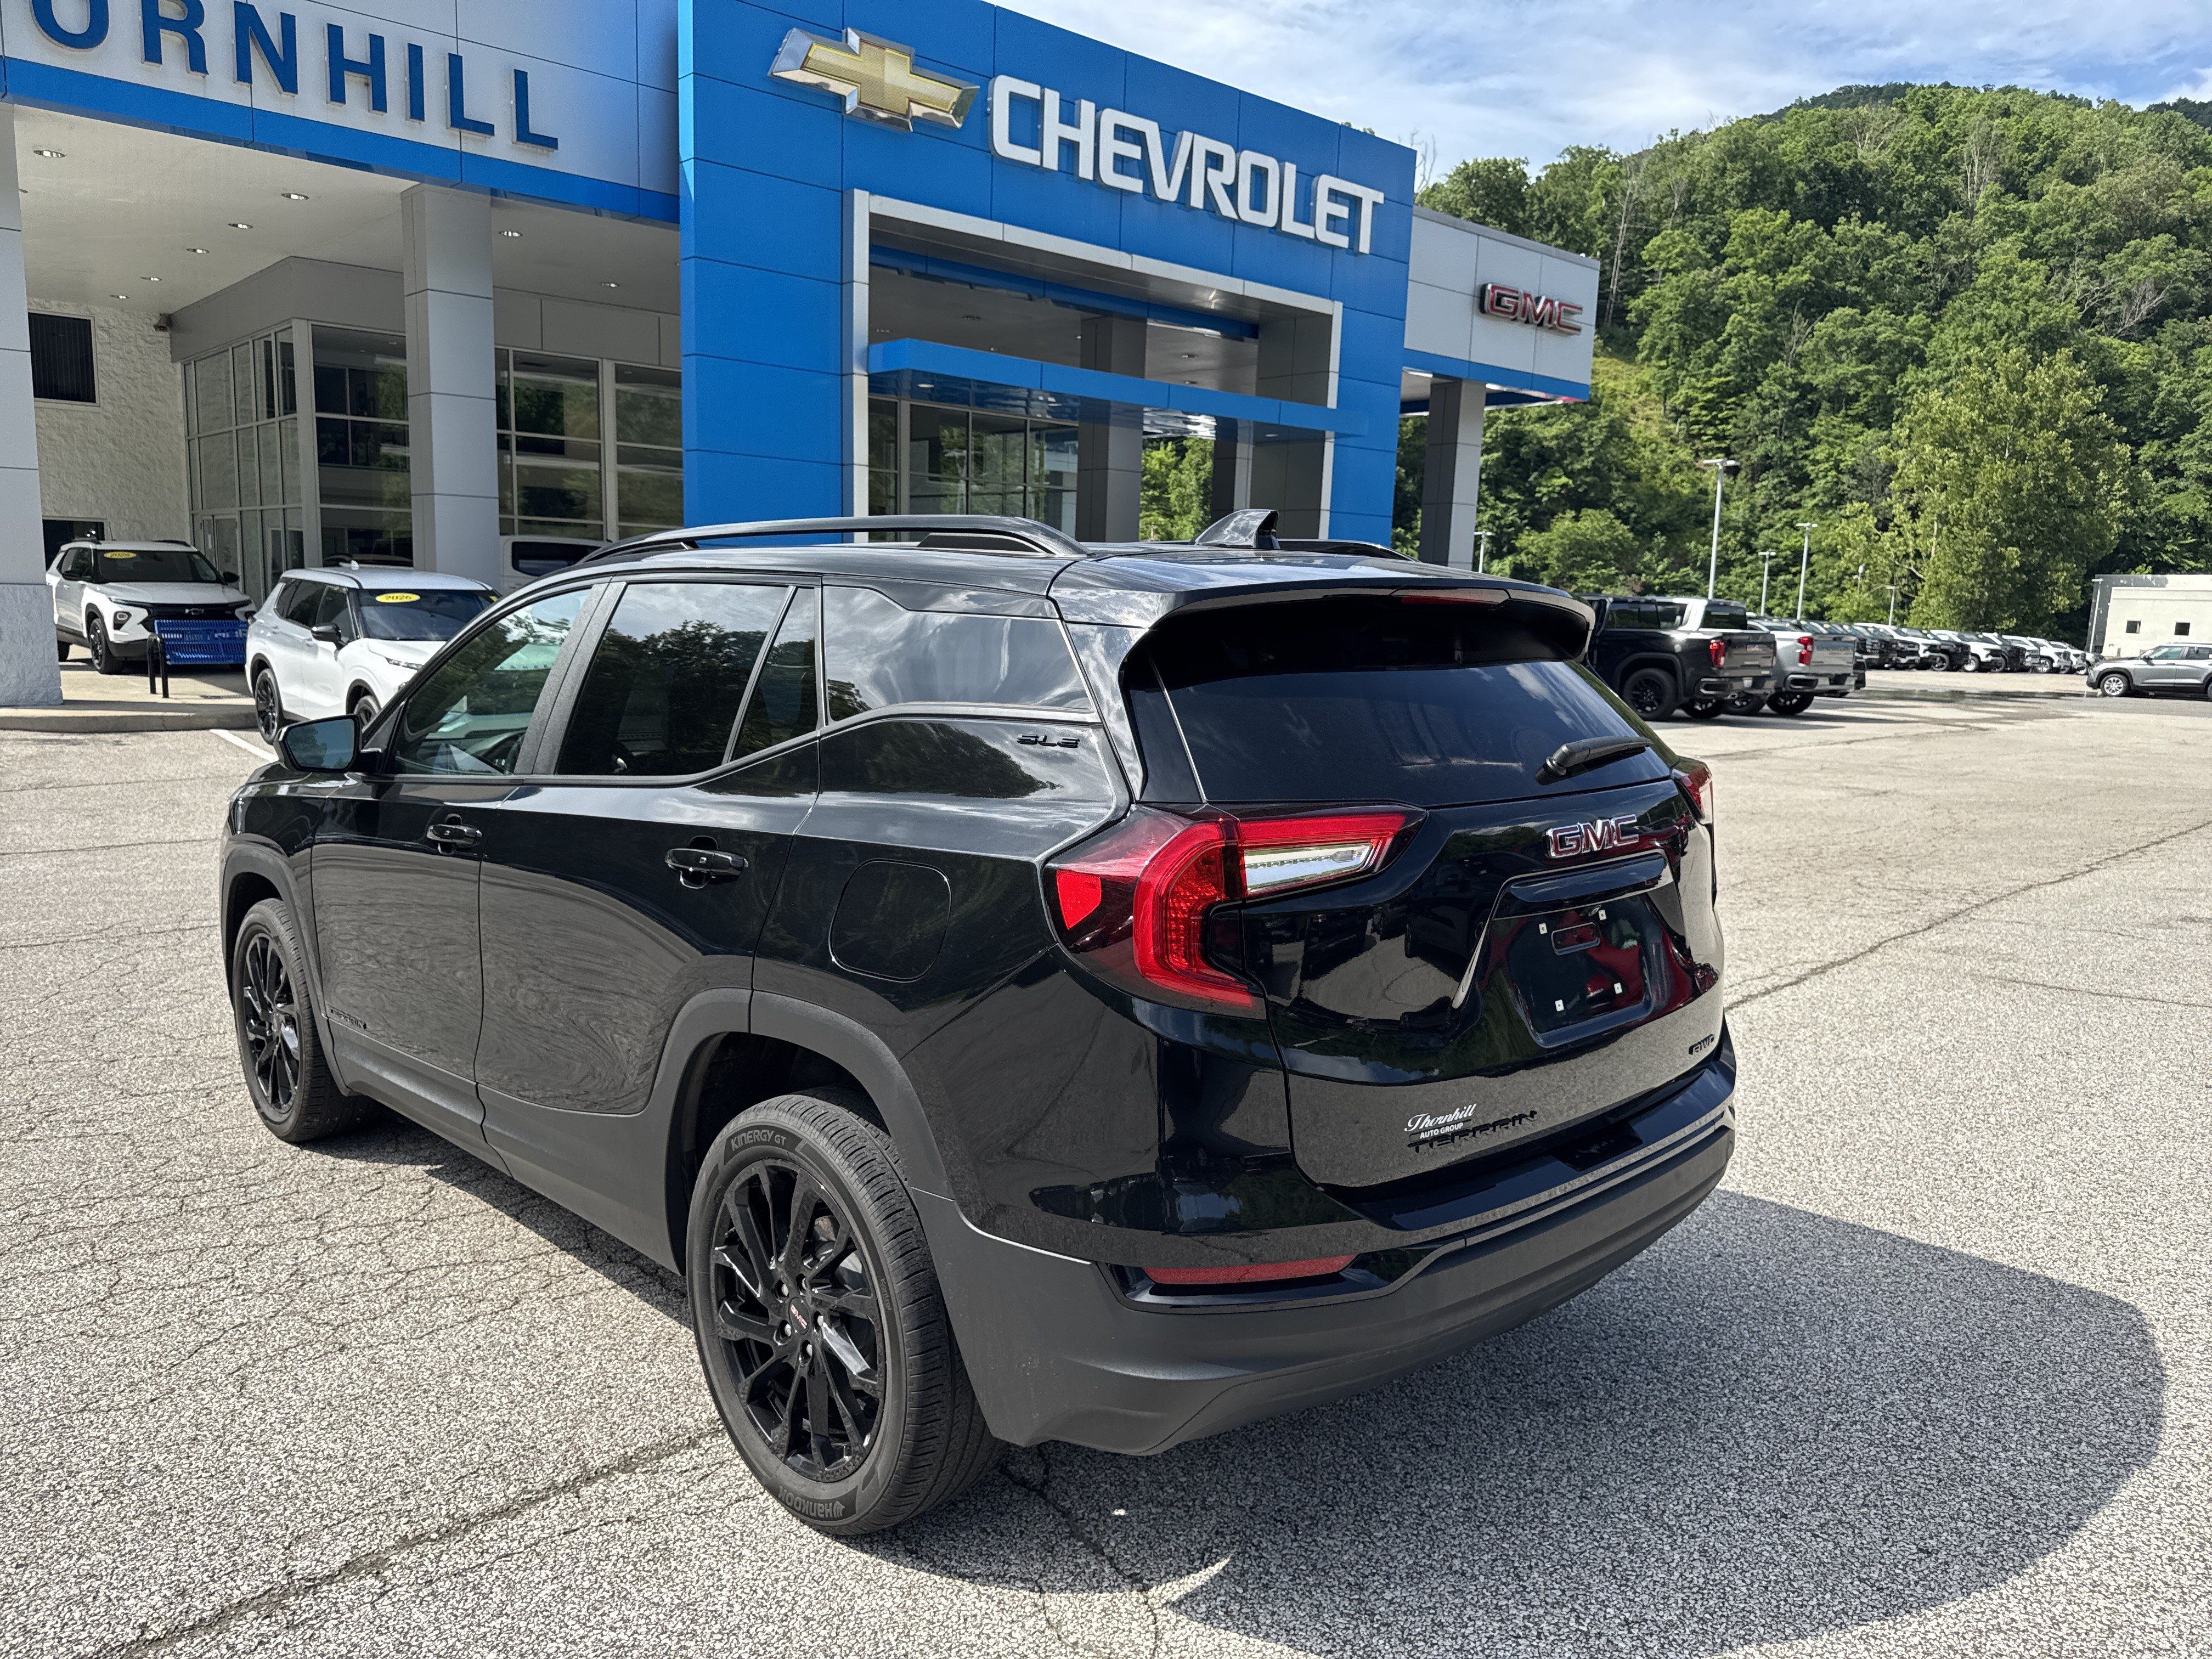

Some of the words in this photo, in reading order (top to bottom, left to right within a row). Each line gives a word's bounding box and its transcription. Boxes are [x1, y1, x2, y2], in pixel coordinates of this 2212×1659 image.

[989, 75, 1384, 254] CHEVROLET
[1480, 283, 1583, 336] GMC
[1017, 734, 1080, 748] SLE
[1545, 814, 1639, 859] GMC
[1404, 1103, 1477, 1132] Thornhill
[1407, 1110, 1538, 1153] TERRAIN
[1419, 1128, 1439, 1139] AUTO
[1440, 1122, 1464, 1135] GROUP
[731, 1129, 774, 1152] KINERGY
[774, 1134, 787, 1146] GT
